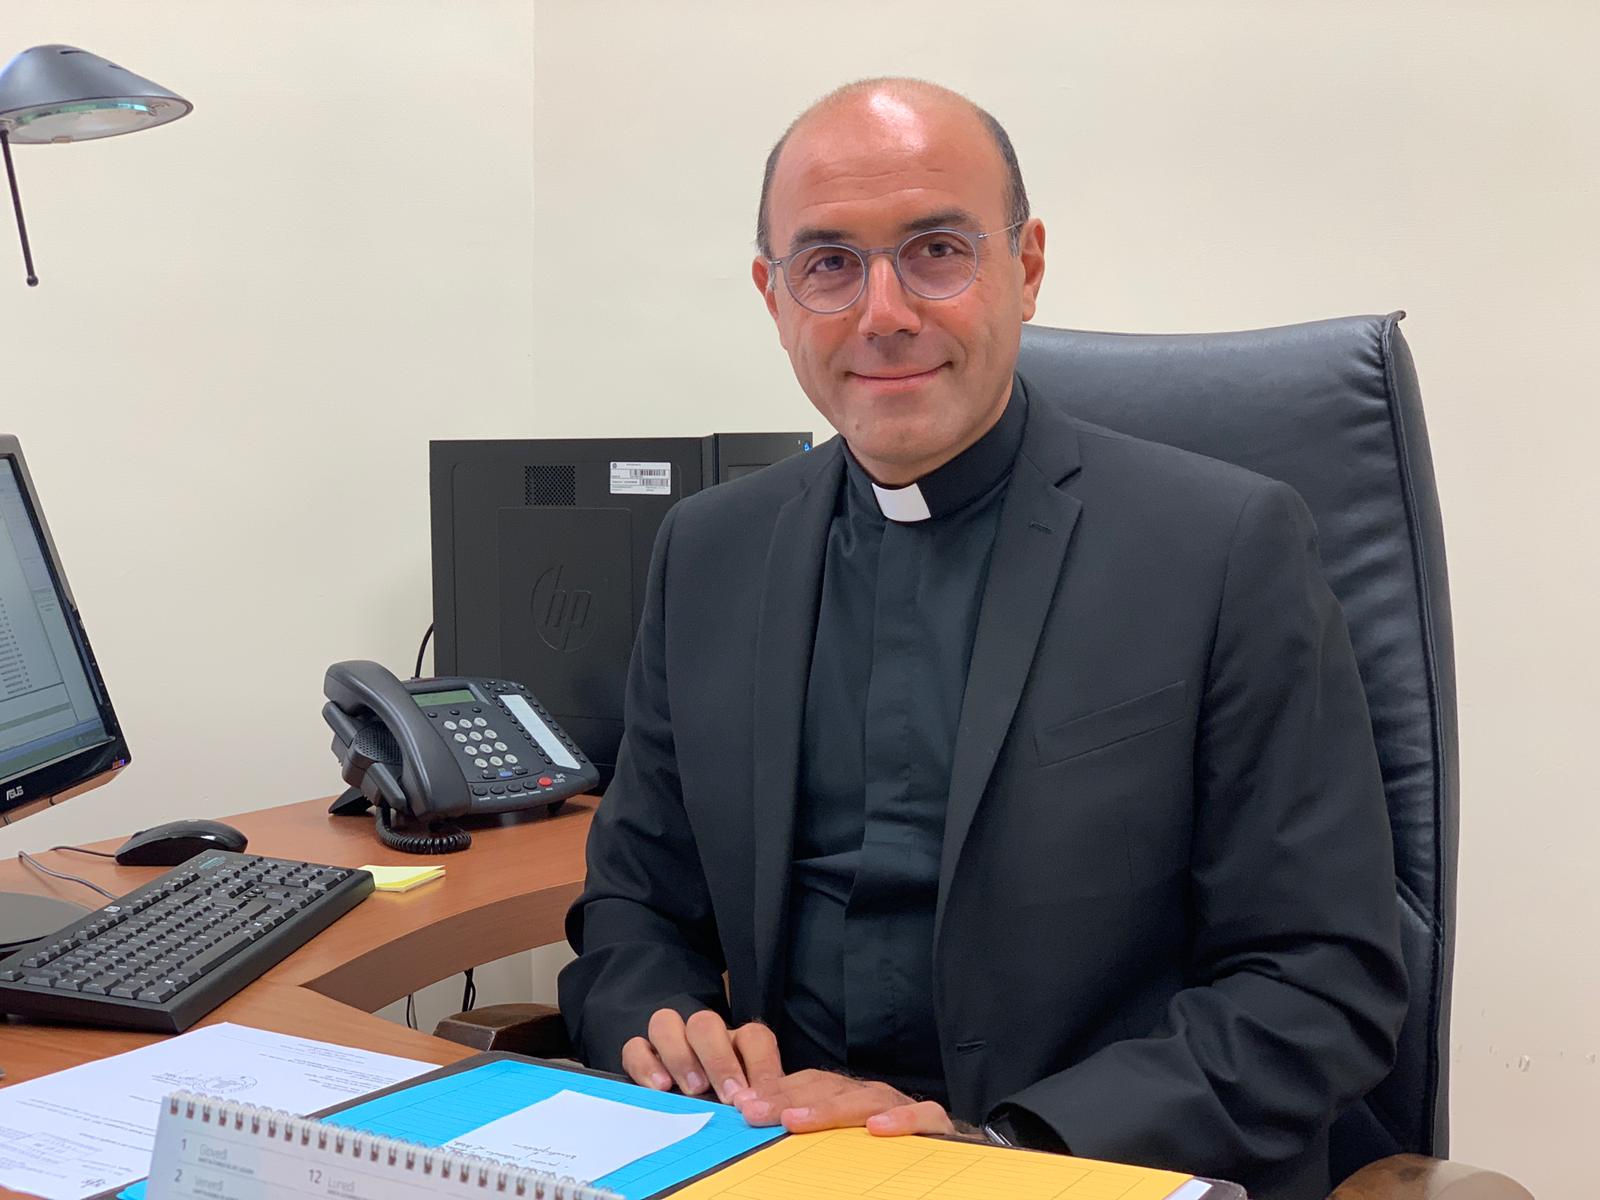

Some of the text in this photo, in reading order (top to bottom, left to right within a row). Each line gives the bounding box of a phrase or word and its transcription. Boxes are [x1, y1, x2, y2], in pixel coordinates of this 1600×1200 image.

[6, 785, 24, 801] ASUS
[181, 1138, 188, 1151] 1
[174, 1168, 183, 1183] 2
[309, 1168, 323, 1184] 12
